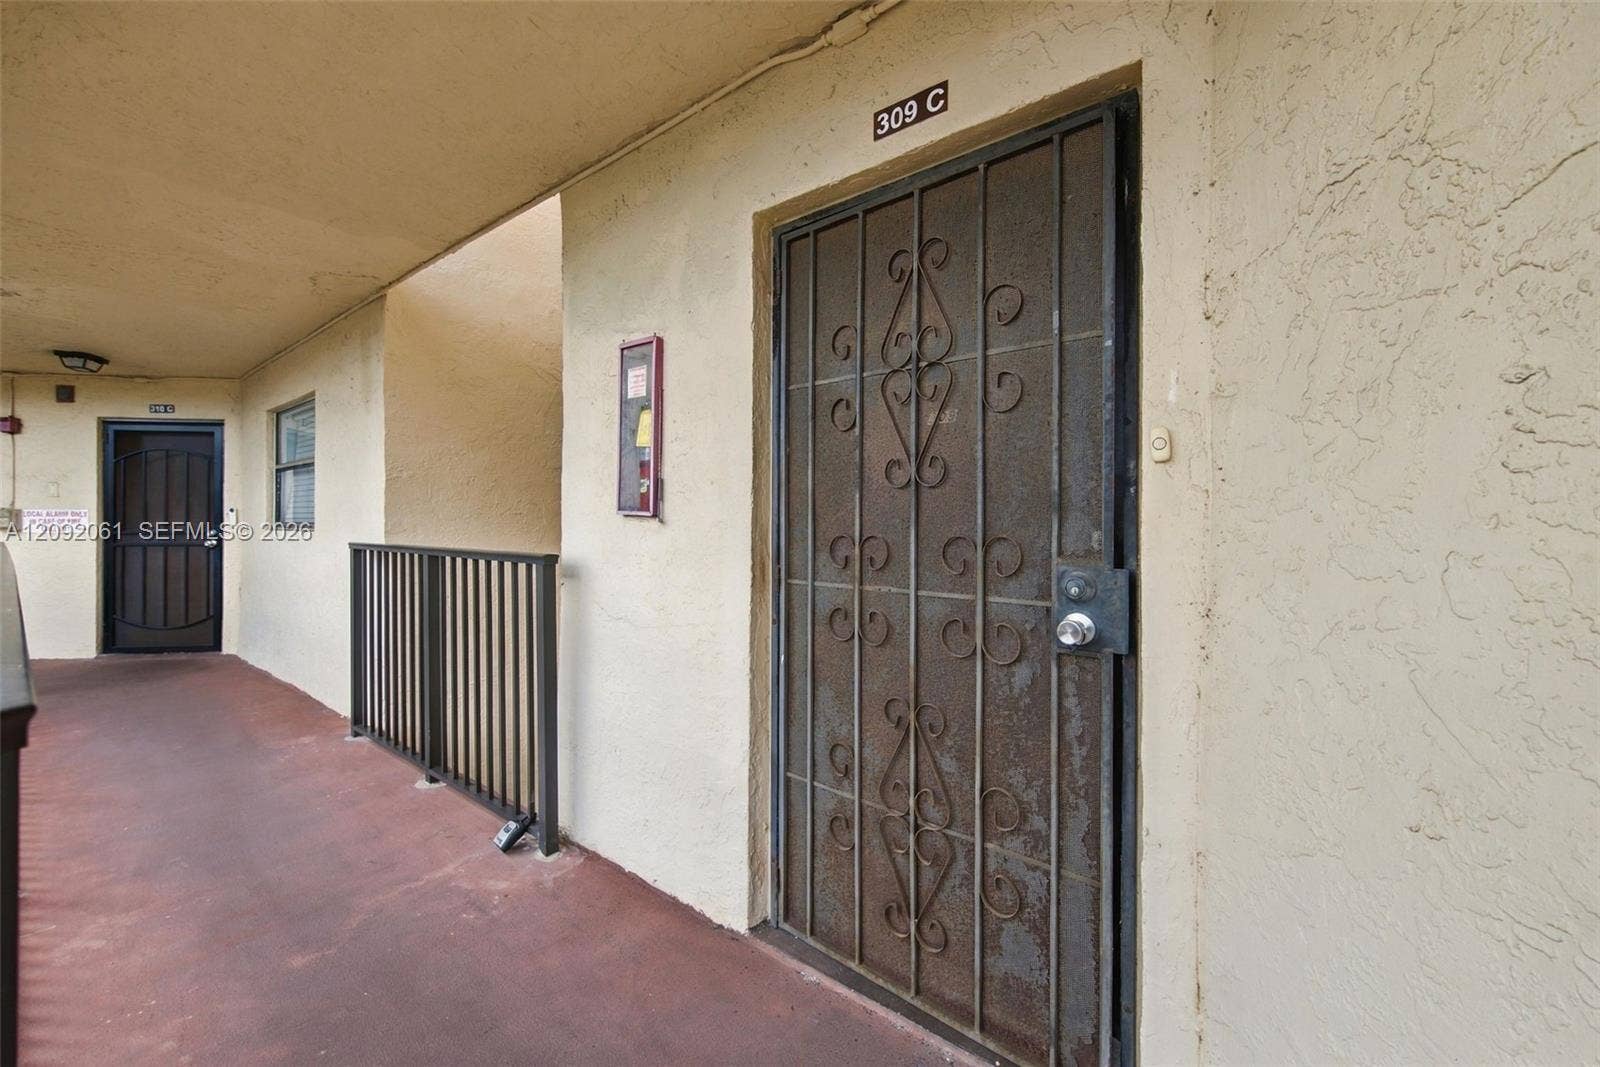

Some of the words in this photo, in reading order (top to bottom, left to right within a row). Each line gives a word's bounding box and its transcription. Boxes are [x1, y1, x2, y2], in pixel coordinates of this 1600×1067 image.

[876, 99, 918, 135] 309
[926, 87, 945, 113] C
[166, 405, 174, 413] C
